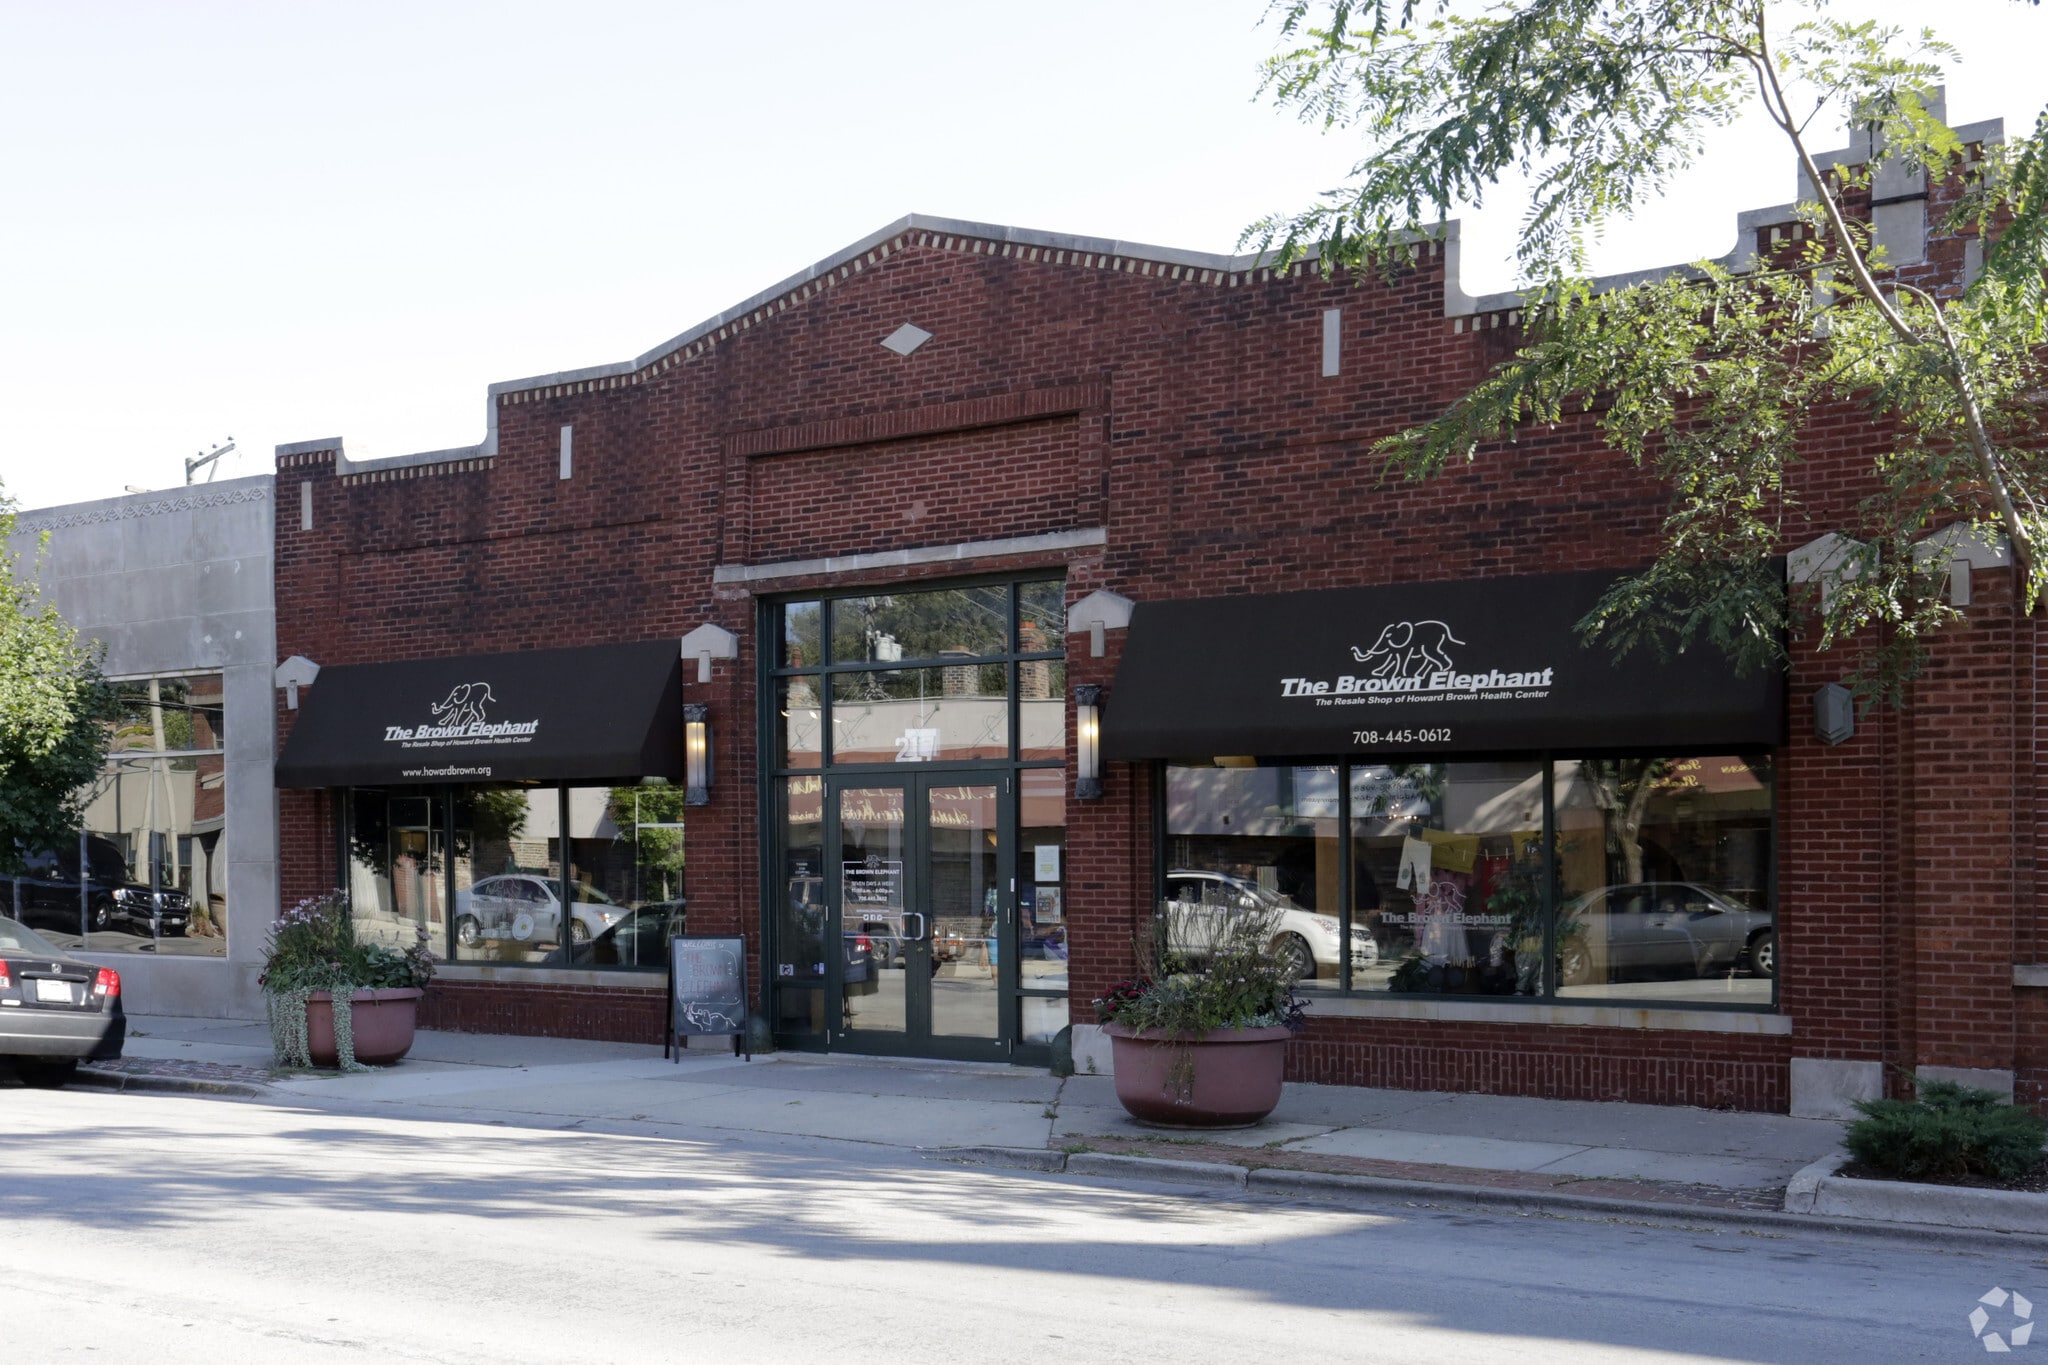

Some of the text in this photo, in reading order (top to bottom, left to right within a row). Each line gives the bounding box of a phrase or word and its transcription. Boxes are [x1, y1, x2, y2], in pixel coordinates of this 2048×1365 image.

[1280, 667, 1554, 697] The Brown Elephant
[1315, 690, 1550, 706] The Resale Shop of Howard Brown Health Center
[384, 719, 539, 741] The Brown Elephant
[1352, 728, 1452, 744] 708-445-0612
[430, 740, 446, 748] Shop
[453, 738, 475, 746] Howard
[895, 736, 935, 762] 217
[402, 764, 492, 777] www.howardbrown.org
[1380, 912, 1406, 924] The
[1453, 912, 1512, 926] Elephant
